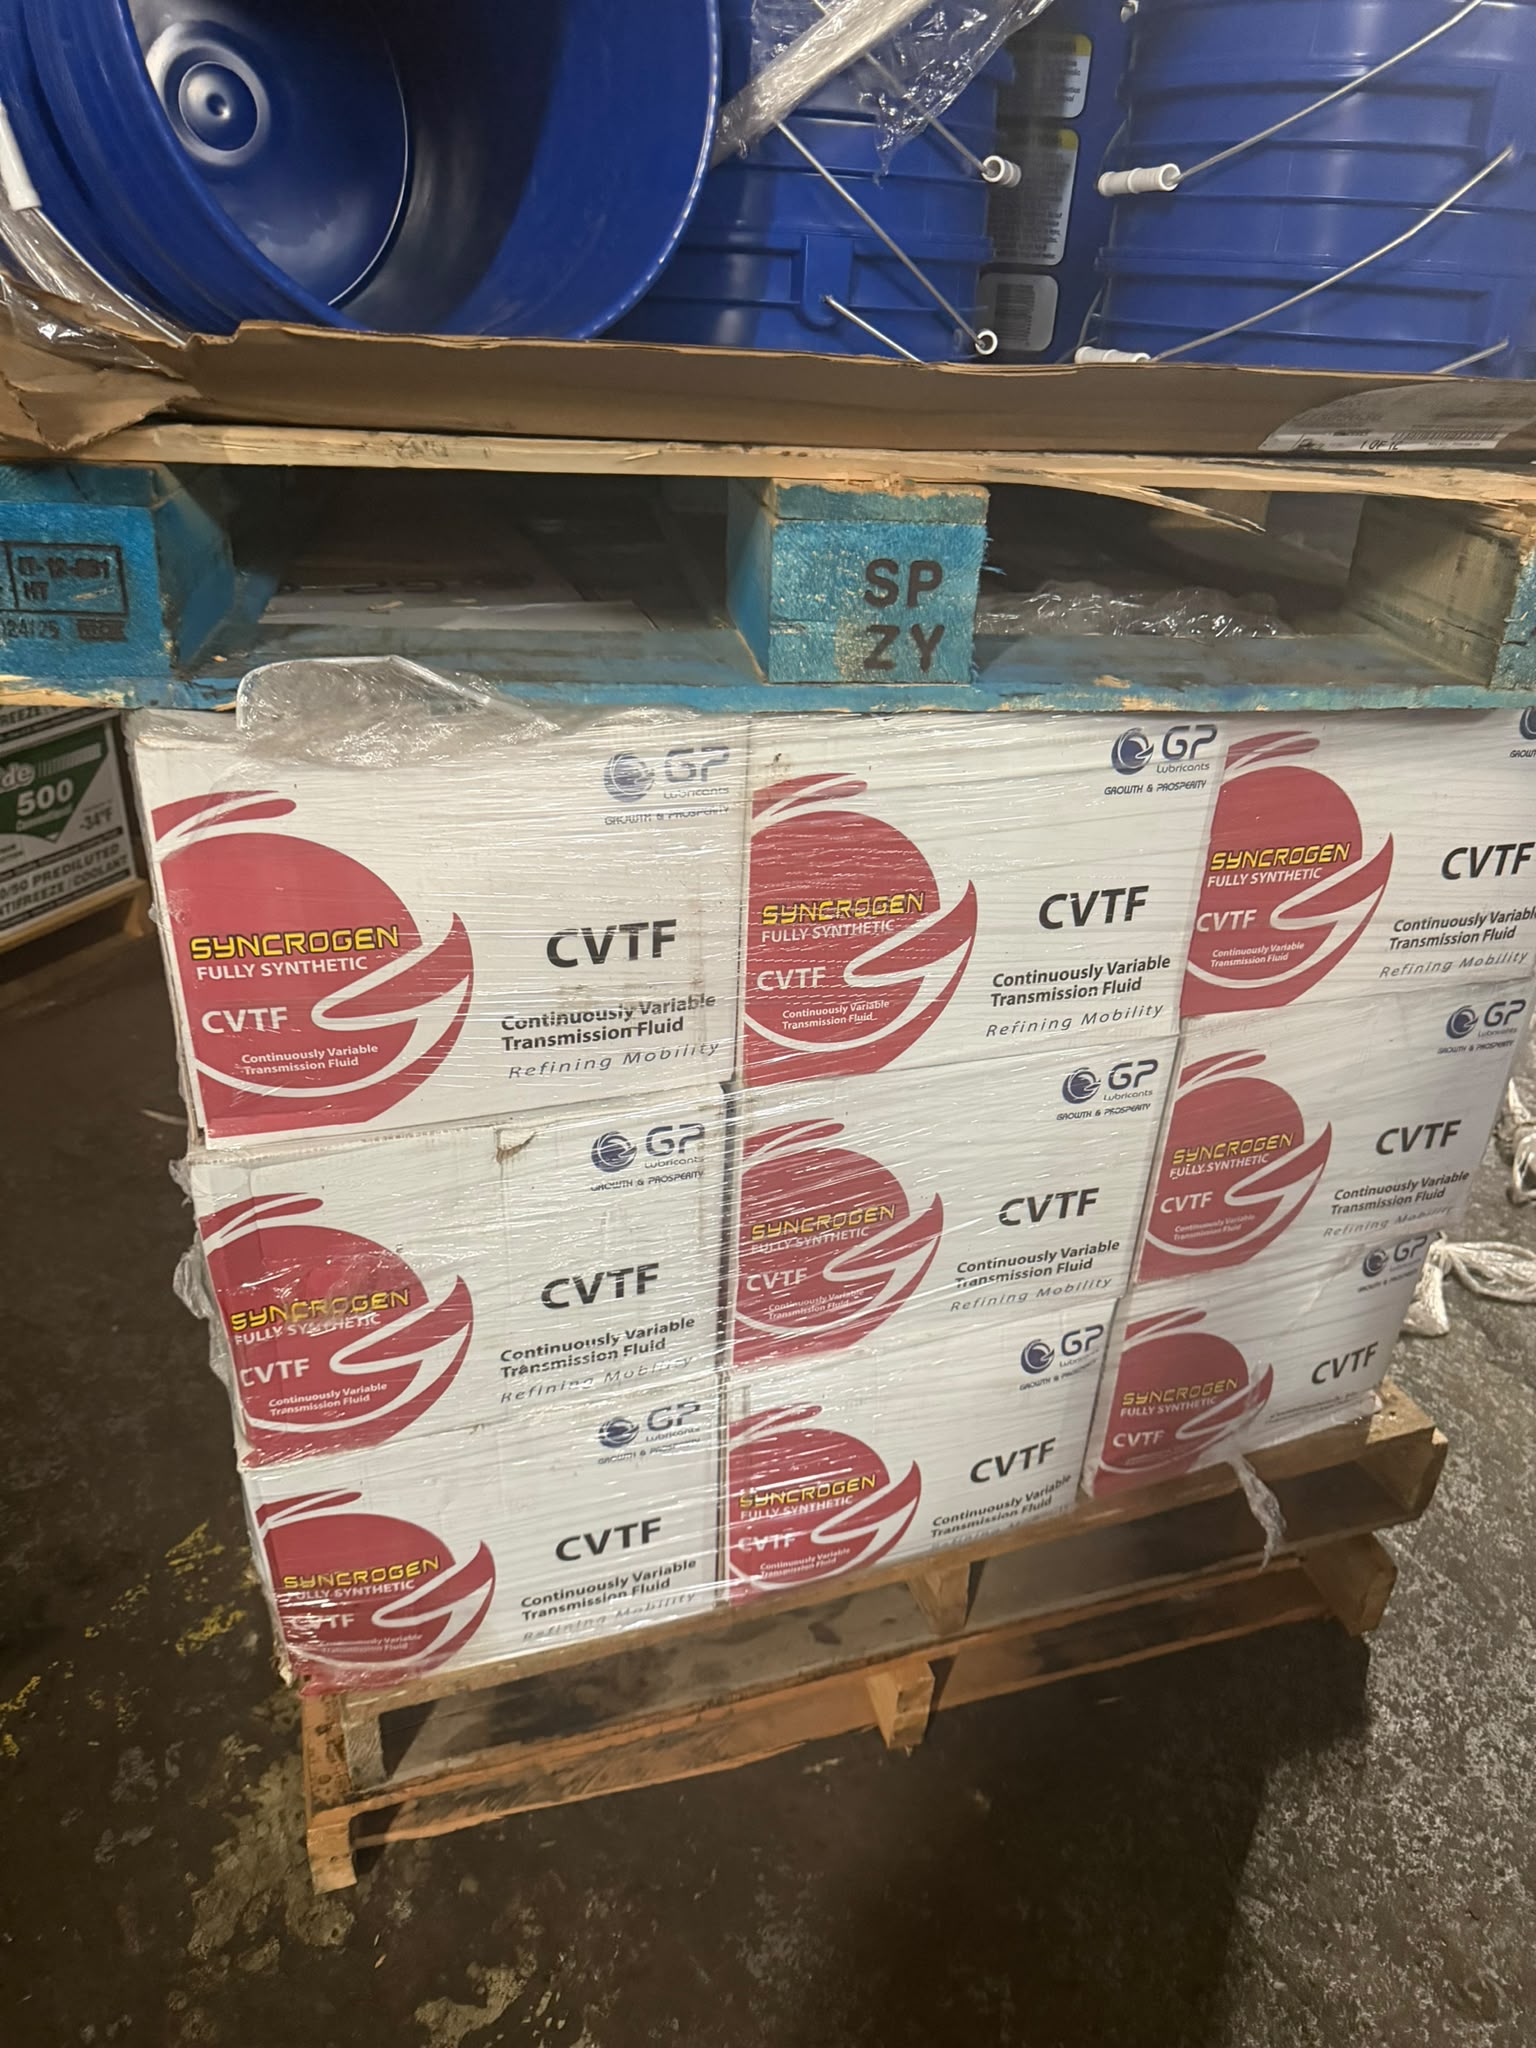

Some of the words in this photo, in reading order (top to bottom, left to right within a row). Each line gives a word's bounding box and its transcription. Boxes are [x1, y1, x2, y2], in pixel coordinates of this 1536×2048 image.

[864, 559, 943, 608] SP
[864, 623, 945, 673] ZY
[1162, 724, 1218, 761] GP
[17, 778, 73, 816] 500
[32, 843, 120, 886] PREDILUTED
[1210, 842, 1351, 871] SYNCROGEN
[1441, 842, 1536, 880] CVTF
[1207, 874, 1249, 888] FULLY
[1250, 867, 1323, 884] SYNTHETIC
[761, 891, 925, 926] SYNCROGEN
[1039, 885, 1149, 929] CVTF
[1197, 909, 1257, 932] CVTF
[1393, 912, 1488, 932] Continuously
[190, 925, 400, 962] SYNCROGEN
[547, 919, 676, 967] CVTF
[761, 929, 808, 942] FULLY
[812, 919, 895, 939] SYNTHETIC
[1389, 932, 1478, 951] Transmission
[1483, 925, 1517, 942] Fluid
[1210, 955, 1265, 967] Transmission
[1267, 953, 1289, 962] Fluid
[1212, 944, 1268, 957] Continuously
[1271, 942, 1304, 951] Variable
[1379, 960, 1453, 978] Refining
[1459, 952, 1528, 968] Mobility
[196, 964, 255, 980] FULLY
[261, 956, 367, 977] SYNTHETIC
[757, 966, 826, 991] CVTF
[993, 964, 1103, 988] Continuously
[1107, 955, 1170, 975] Variable
[991, 985, 1098, 1007] Transmission
[1103, 977, 1142, 995] Fluid
[202, 1007, 288, 1034] CVTF
[502, 1005, 634, 1031] Continuously
[639, 993, 716, 1015] Variable
[782, 1005, 848, 1019] Continuously
[850, 1000, 890, 1011] Variable
[782, 1017, 847, 1030] Transmission
[849, 1013, 873, 1023] Fluid
[986, 1017, 1072, 1037] Refining
[1081, 1004, 1163, 1026] Mobility
[1484, 999, 1526, 1027] GP
[502, 1027, 632, 1051] Transmission
[638, 1017, 683, 1036] Fluid
[241, 1049, 325, 1064] Continuously
[328, 1044, 378, 1056] Variable
[244, 1061, 325, 1075] Transmission
[328, 1057, 359, 1068] Fluid
[509, 1057, 611, 1079] Refining
[623, 1042, 719, 1065] Mobility
[1108, 1059, 1158, 1090] GP
[646, 1123, 705, 1156] GP
[1172, 1133, 1294, 1165] SYNCROGEN
[1376, 1120, 1461, 1155] CVTF
[1169, 1165, 1204, 1178] FULLY
[1206, 1153, 1270, 1173] SYNTHETIC
[1160, 1191, 1213, 1213] CVTF
[1331, 1193, 1412, 1215] Transmission
[1415, 1188, 1446, 1203] Fluid
[1334, 1179, 1420, 1201] Continuously
[1421, 1171, 1469, 1187] Variable
[751, 1204, 896, 1242] SYNCROGEN
[999, 1188, 1099, 1226] CVTF
[797, 1227, 869, 1246] SYNTHETIC
[1394, 1235, 1427, 1262] GP
[955, 1265, 1052, 1288] Transmission
[1056, 1258, 1093, 1274] Fluid
[957, 1251, 1057, 1274] Continuously
[1061, 1240, 1120, 1259] Variable
[541, 1263, 659, 1309] CVTF
[746, 1268, 807, 1292] CVTF
[951, 1291, 1028, 1312] Refining
[1036, 1278, 1112, 1298] Mobility
[230, 1289, 410, 1332] SYNCROGEN
[235, 1326, 283, 1345] FULLY
[288, 1313, 381, 1336] SYNTHETIC
[500, 1331, 620, 1362] Continuously
[625, 1317, 695, 1340] Variable
[1062, 1324, 1104, 1356] GP
[240, 1358, 310, 1387] CVTF
[501, 1349, 618, 1379] Transmission
[624, 1338, 666, 1356] Fluid
[1311, 1341, 1378, 1384] CVTF
[269, 1389, 340, 1408] Continuously
[342, 1382, 387, 1396] Variable
[270, 1401, 341, 1417] Transmission
[343, 1394, 370, 1405] Fluid
[1121, 1406, 1155, 1417] FULLY
[1157, 1396, 1217, 1414] SYNTHETIC
[1122, 1377, 1239, 1407] SYNCROGEN
[1113, 1430, 1165, 1448] CVTF
[970, 1437, 1055, 1483] CVTF
[739, 1474, 876, 1510] SYNCROGEN
[783, 1495, 853, 1516] SYNTHETIC
[933, 1497, 1022, 1527] Continuously
[1026, 1475, 1071, 1502] Variable
[931, 1507, 1018, 1538] Transmission
[1021, 1495, 1052, 1514] Fluid
[556, 1517, 661, 1562] CVTF
[283, 1555, 440, 1590] SYNCROGEN
[335, 1580, 415, 1597] SYNTHETIC
[521, 1576, 628, 1608] Continuously
[633, 1560, 696, 1582] Variable
[522, 1590, 627, 1621] Transmission
[632, 1578, 670, 1597] Fluid
